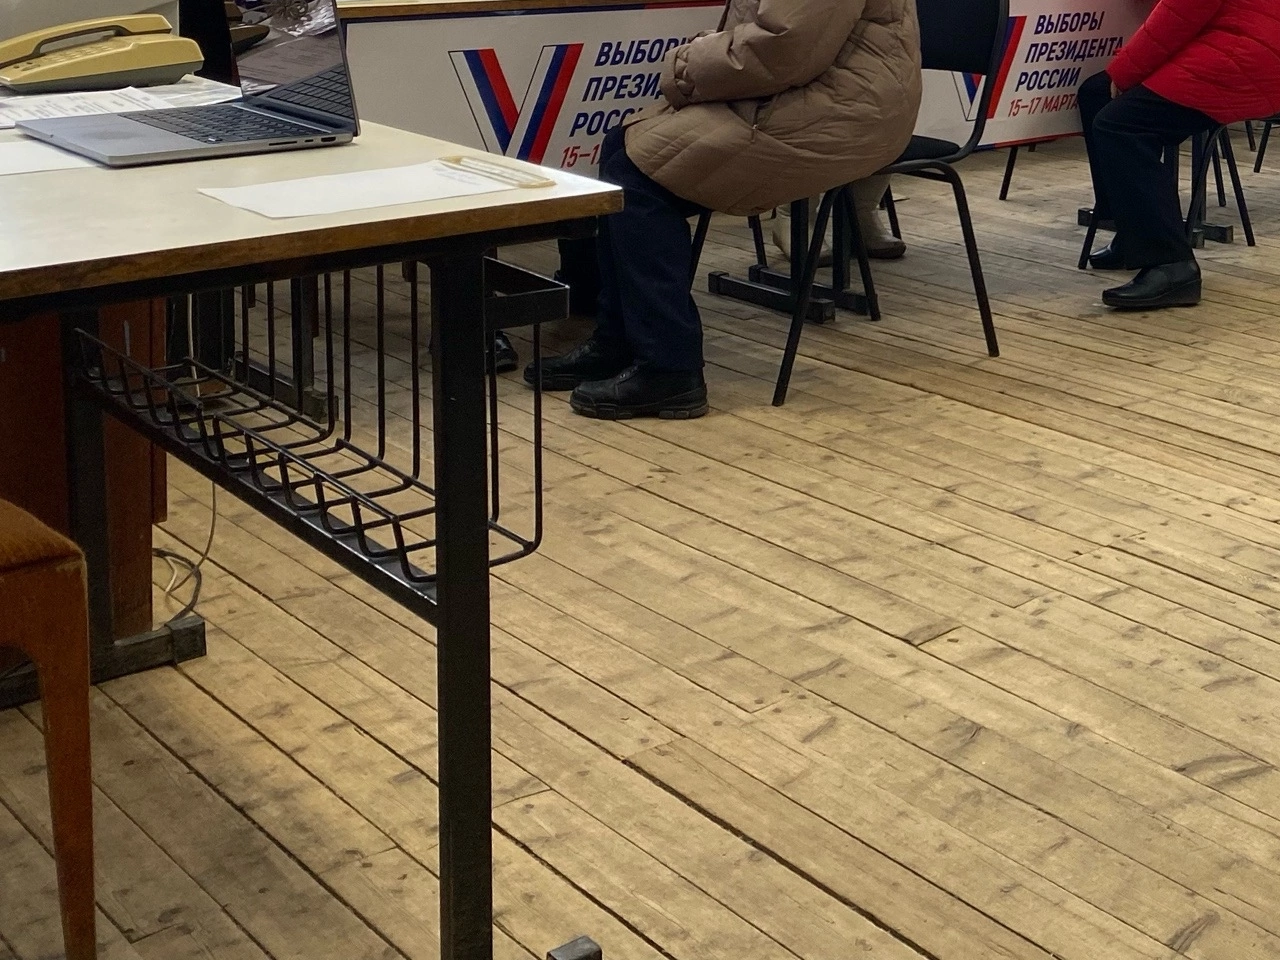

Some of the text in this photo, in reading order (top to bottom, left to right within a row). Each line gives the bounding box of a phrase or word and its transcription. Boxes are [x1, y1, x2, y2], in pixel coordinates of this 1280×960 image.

[1034, 11, 1105, 35] ВЫБОРЫ
[594, 37, 687, 67] ВЫБОР
[1024, 36, 1124, 64] ПРЕЗИДЕНТА
[582, 71, 664, 102] ПРЕЗИ
[1015, 67, 1082, 93] РОССИИ
[1041, 93, 1079, 112] МАРТА
[569, 107, 643, 137] РОСС
[560, 143, 600, 168] 15–1
